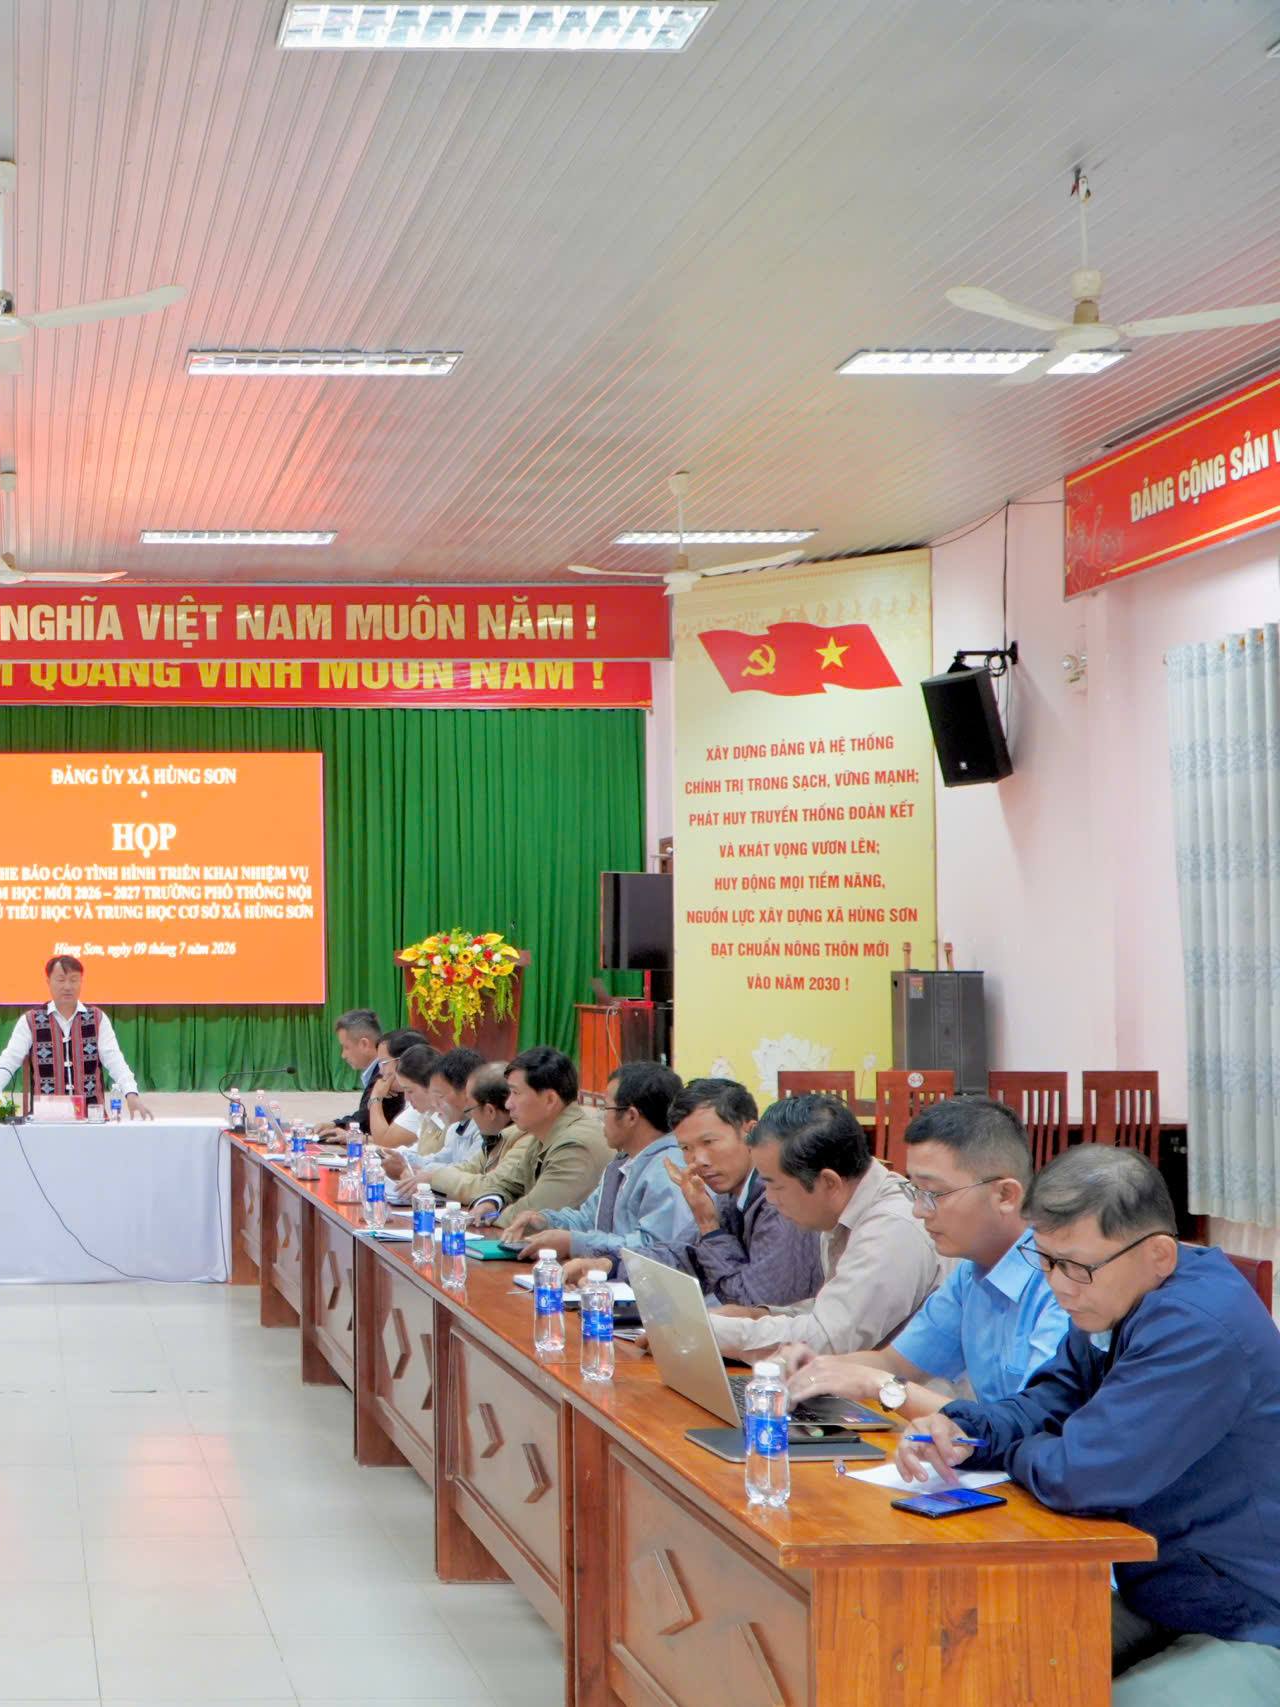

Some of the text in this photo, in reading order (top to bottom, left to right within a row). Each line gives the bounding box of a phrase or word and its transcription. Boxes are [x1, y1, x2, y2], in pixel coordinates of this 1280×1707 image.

[1130, 477, 1174, 522] ĐẢNG
[1178, 454, 1226, 505] CỘNG
[1230, 431, 1268, 480] SẢN
[0, 596, 122, 642] NGHĨA
[137, 595, 222, 648] VIỆT
[236, 604, 331, 641] NAM
[346, 596, 465, 641] MUÔN
[478, 596, 574, 640] NĂM
[586, 604, 596, 640] !
[30, 662, 180, 691] QUANG
[197, 662, 301, 688] VINH
[592, 662, 604, 689] !
[706, 732, 894, 763] XÂY DỰNG ĐẢNG VÀ HỆ THỐNG
[51, 765, 236, 785] ĐẢNG ỦY XÃ HÙNG SƠN
[685, 768, 918, 795] CHÍNH TRỊ TRONG SẠCH, VỮNG MẠNH;
[689, 809, 719, 827] PHÁT
[723, 809, 747, 825] HUY
[802, 801, 845, 822] THỐNG
[849, 802, 885, 820] ĐOÀN
[890, 799, 914, 818] KẾT
[112, 822, 177, 858] HỌP
[720, 838, 880, 859] VÀ KHÁT VỌNG VƯƠN LÊN;
[21, 864, 50, 881] BÁO
[52, 864, 83, 881] CÁO
[85, 864, 118, 881] TÌNH
[121, 864, 156, 881] HÌNH
[159, 864, 200, 880] TRIỂN
[203, 866, 238, 880] KHAI
[241, 865, 287, 883] NHIỆM
[289, 866, 309, 883] VỤ
[714, 875, 737, 891] HUY
[742, 874, 776, 893] ĐỘNG
[780, 875, 804, 892] MỌI
[844, 871, 885, 890] NĂNG,
[11, 886, 41, 902] HỌC
[44, 883, 72, 900] MỚI
[74, 886, 102, 900] 2026
[113, 886, 140, 900] 2027
[143, 883, 201, 900] TRƯỜNG
[204, 882, 233, 900] PHỔ
[236, 882, 284, 900] THÔNG
[287, 885, 312, 902] NỘI
[732, 906, 754, 925] LỰC
[759, 904, 782, 923] XÂY
[787, 907, 822, 924] DỰNG
[826, 905, 843, 922] XÃ
[848, 904, 885, 922] HÙNG
[889, 907, 917, 922] SƠN
[711, 936, 889, 958] ĐẠT CHUẨN NÔNG THÔN MỚI
[747, 972, 849, 991] VÀO NĂM 2030 !
